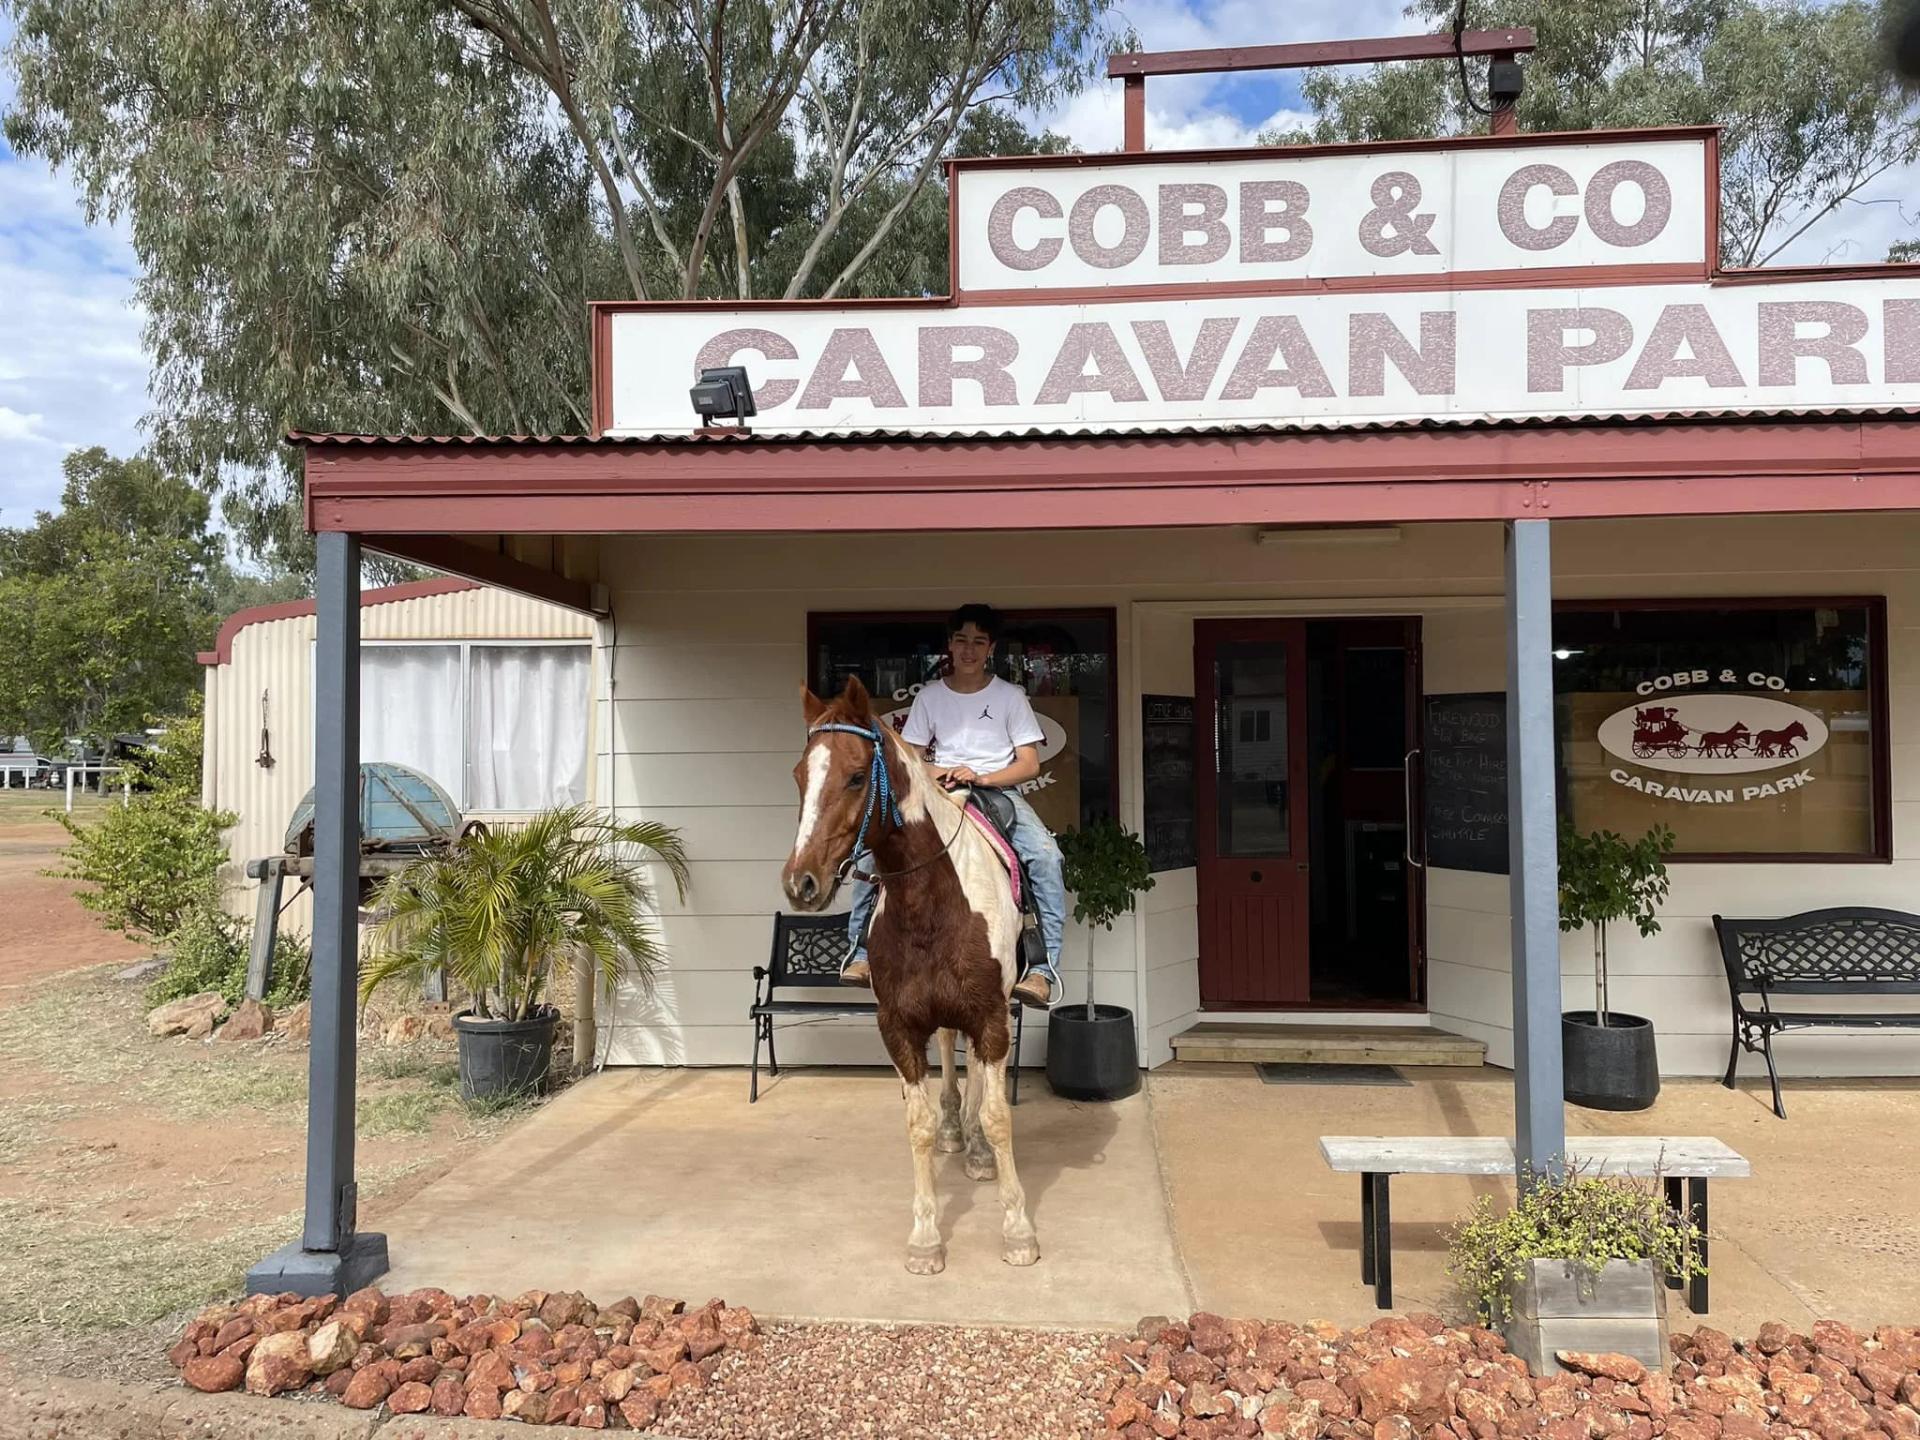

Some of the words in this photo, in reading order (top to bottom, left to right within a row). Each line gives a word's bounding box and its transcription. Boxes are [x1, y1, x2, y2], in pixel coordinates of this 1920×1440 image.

[988, 180, 1313, 271] COBB
[1358, 170, 1440, 258] &
[1497, 159, 1672, 251] CO
[694, 310, 1456, 412] CARAVAN
[1636, 669, 1709, 695] COBB
[1719, 669, 1737, 683] &
[1747, 672, 1790, 693] CO.
[1015, 770, 1057, 795] RK
[1609, 768, 1734, 803] CARAVAN
[1742, 768, 1816, 801] PARK
